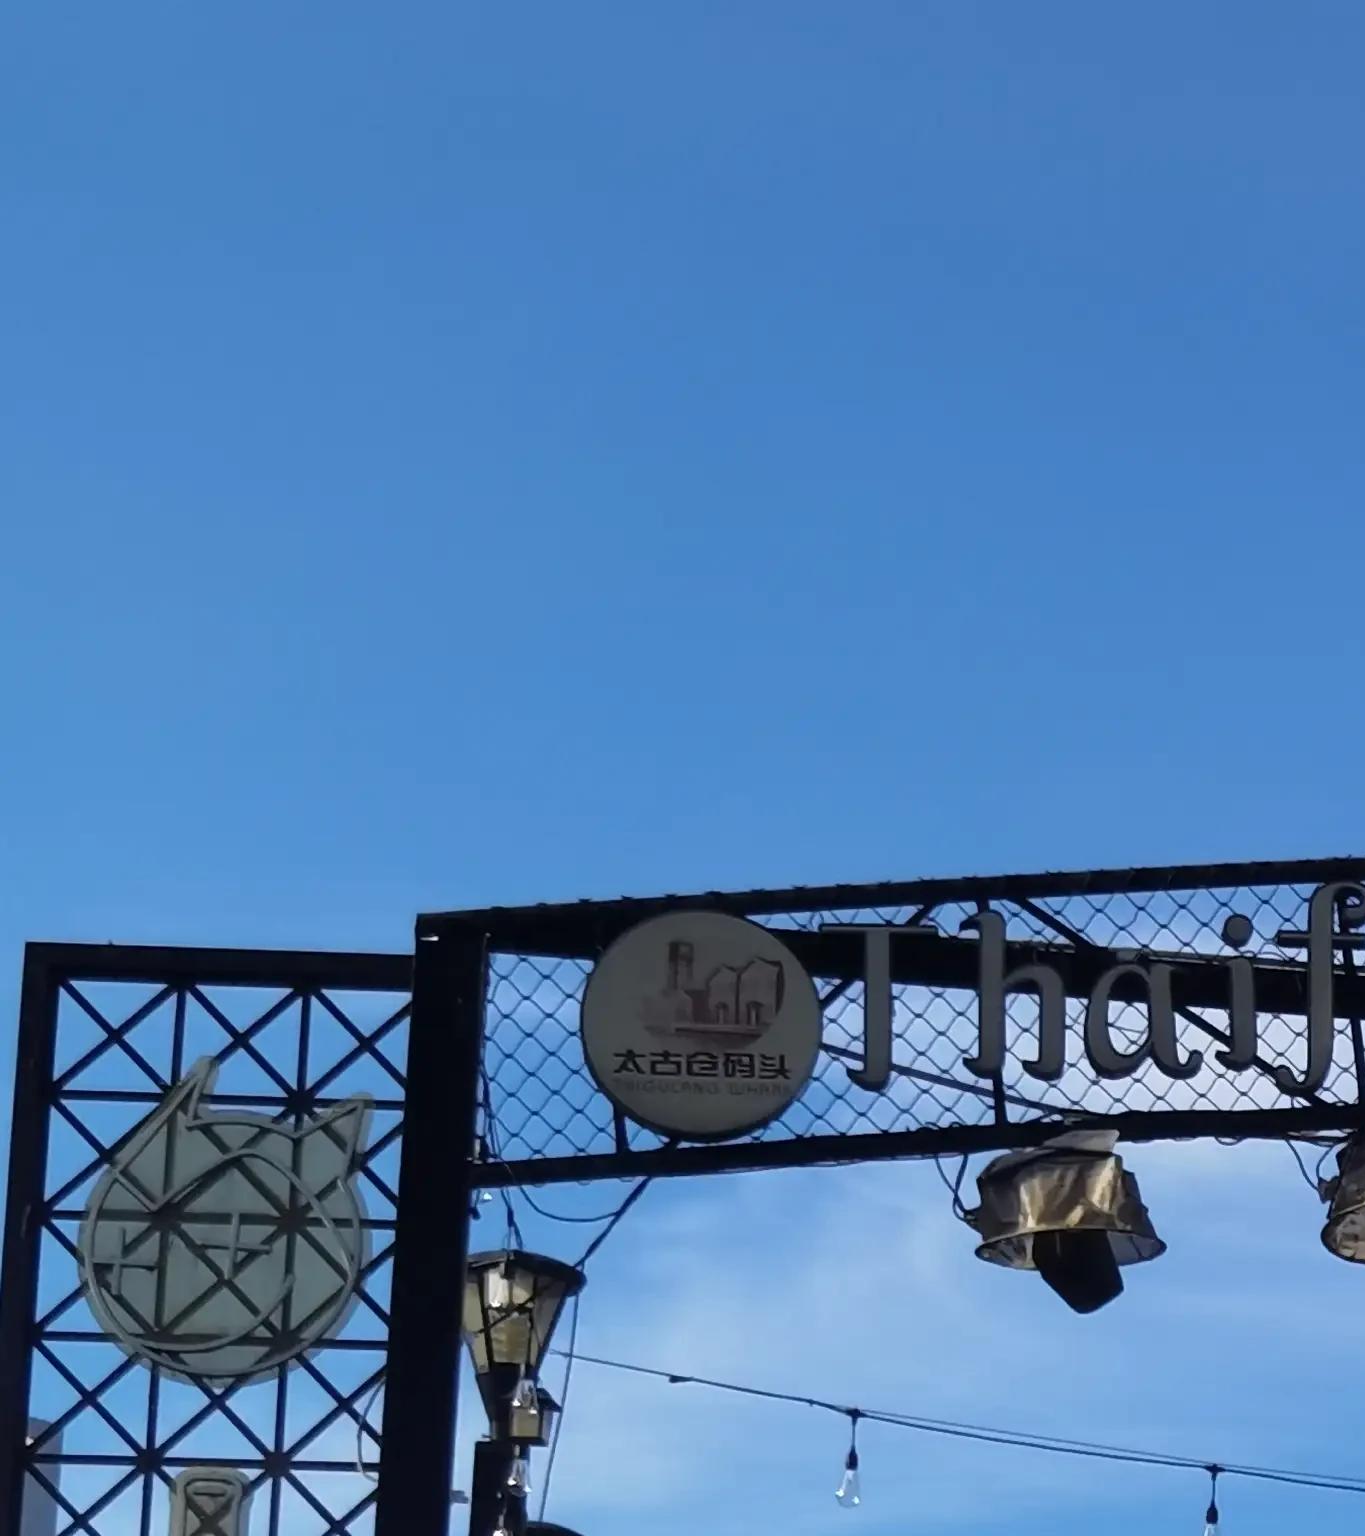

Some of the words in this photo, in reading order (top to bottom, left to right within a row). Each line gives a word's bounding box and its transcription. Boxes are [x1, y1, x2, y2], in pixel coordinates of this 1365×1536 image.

[613, 1049, 792, 1080] 太古仓码头
